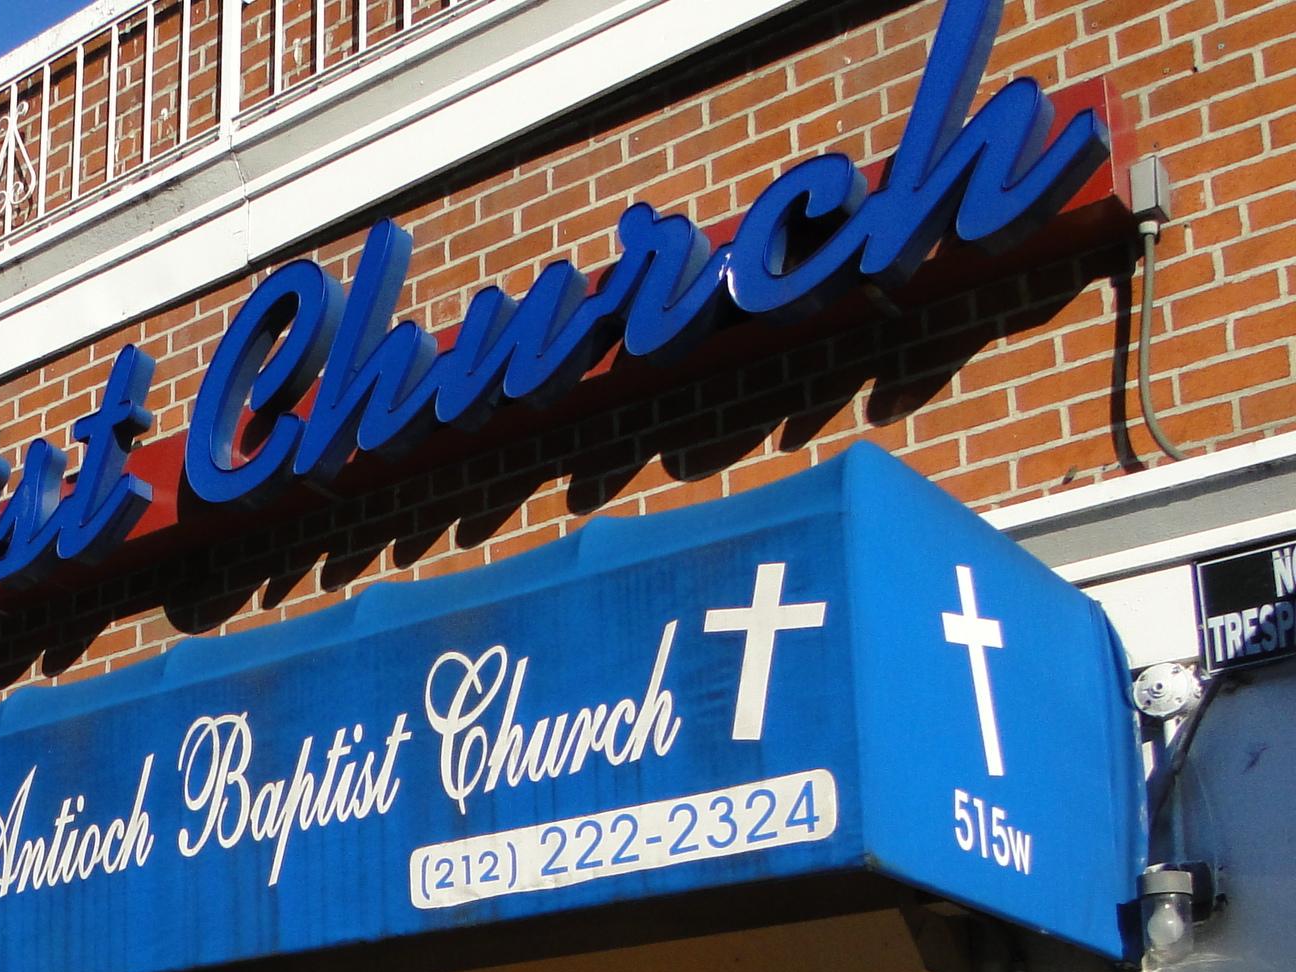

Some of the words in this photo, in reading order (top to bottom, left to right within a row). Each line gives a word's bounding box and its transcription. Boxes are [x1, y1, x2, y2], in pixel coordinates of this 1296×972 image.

[185, 0, 1111, 502] Church
[1271, 546, 1296, 597] N
[178, 711, 412, 887] Baptist
[424, 619, 681, 815] Church
[421, 841, 517, 900] (212)
[540, 780, 821, 878] 222-2324
